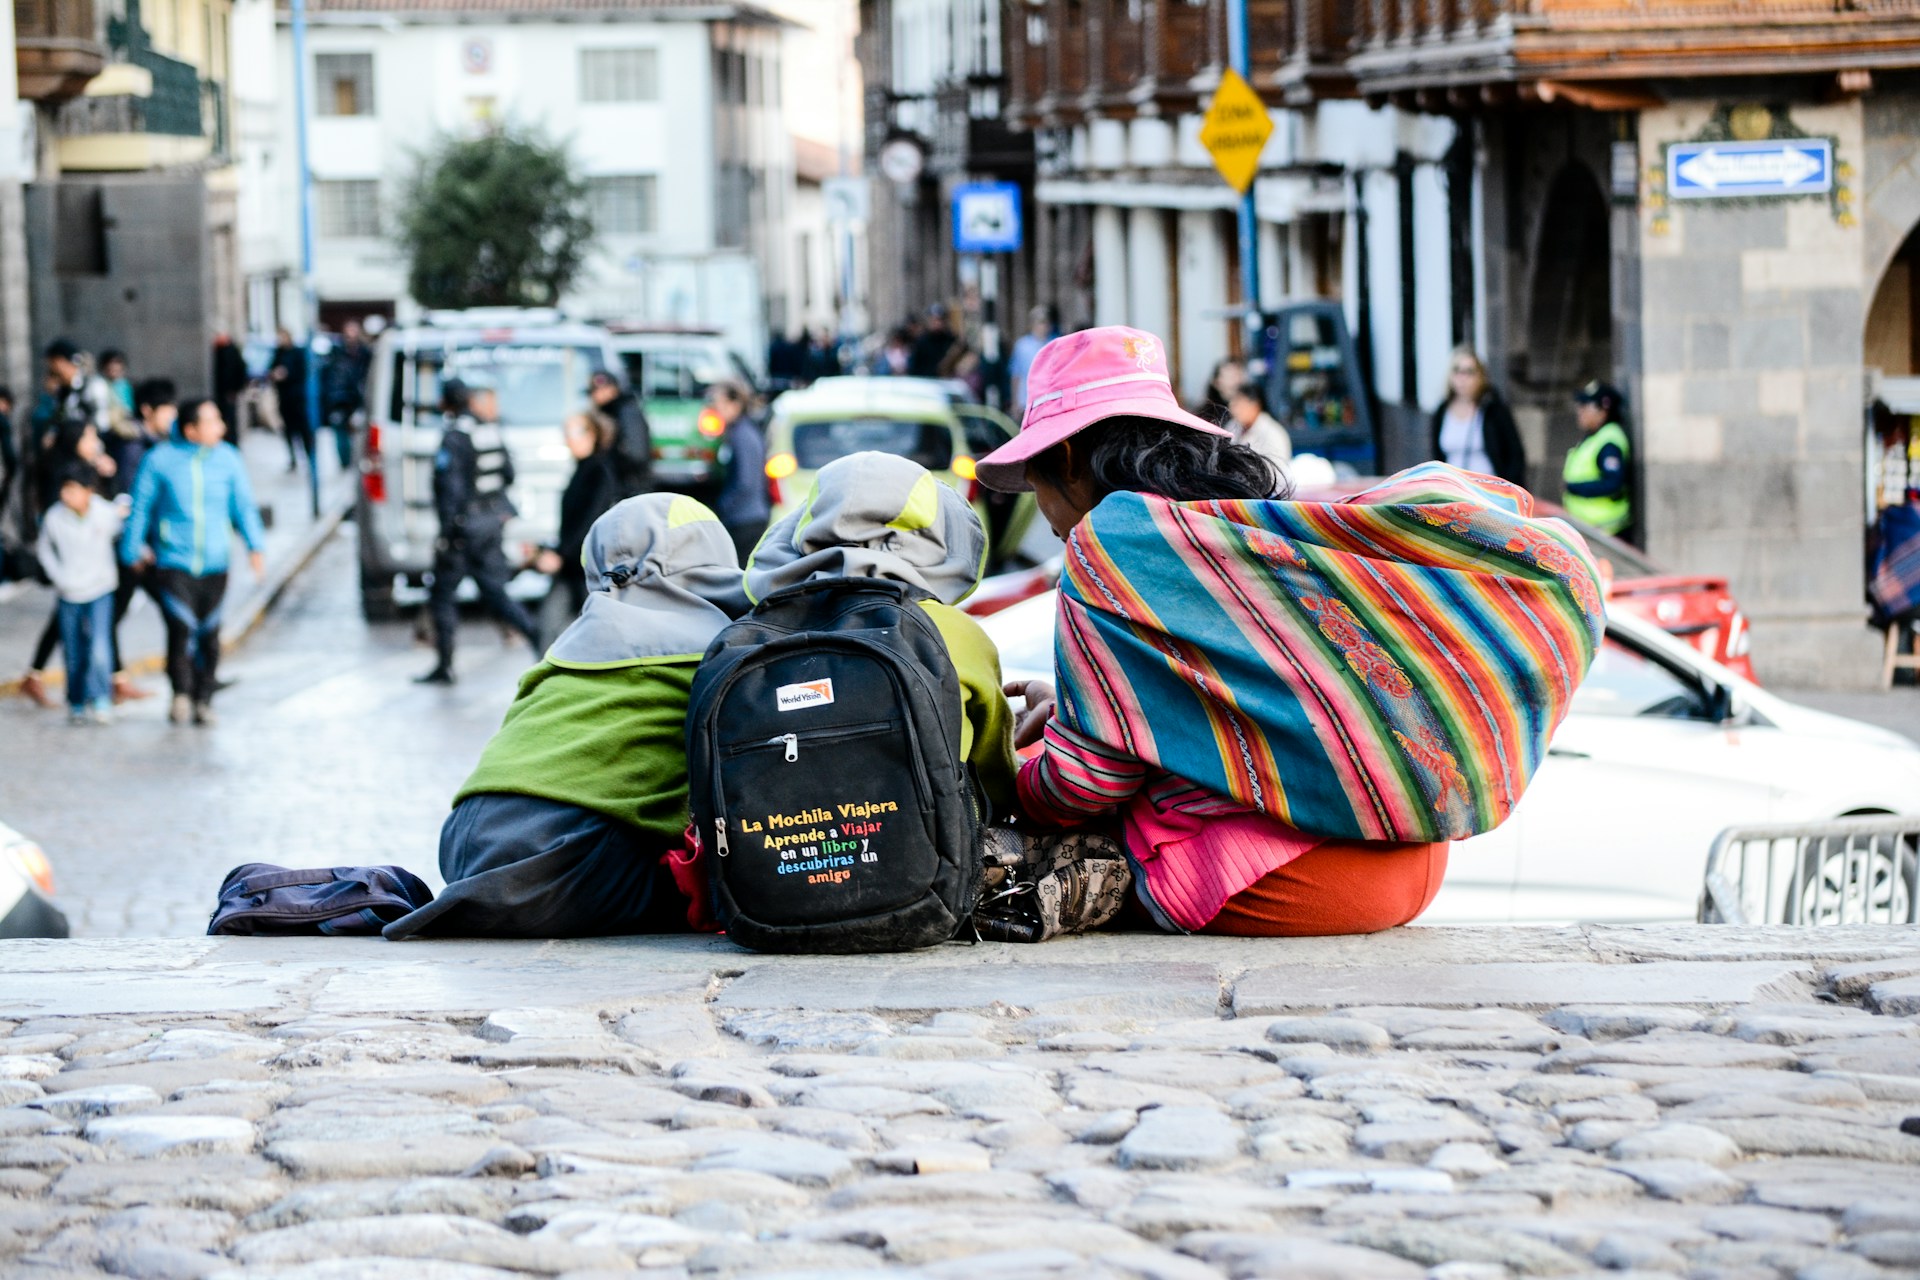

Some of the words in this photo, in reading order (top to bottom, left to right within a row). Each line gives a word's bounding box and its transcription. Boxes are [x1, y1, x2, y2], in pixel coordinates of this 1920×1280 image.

[780, 694, 801, 704] World
[741, 819, 763, 833] La
[768, 807, 833, 830] Mochila
[837, 800, 899, 819] Viajera
[763, 828, 826, 850] Aprende
[829, 828, 838, 839] a
[840, 821, 883, 836] Viajar
[780, 849, 797, 860] en
[801, 846, 818, 858] un
[822, 840, 857, 854] libro
[861, 838, 869, 853] y
[777, 854, 854, 875] descubriras
[808, 869, 851, 884] amigo
